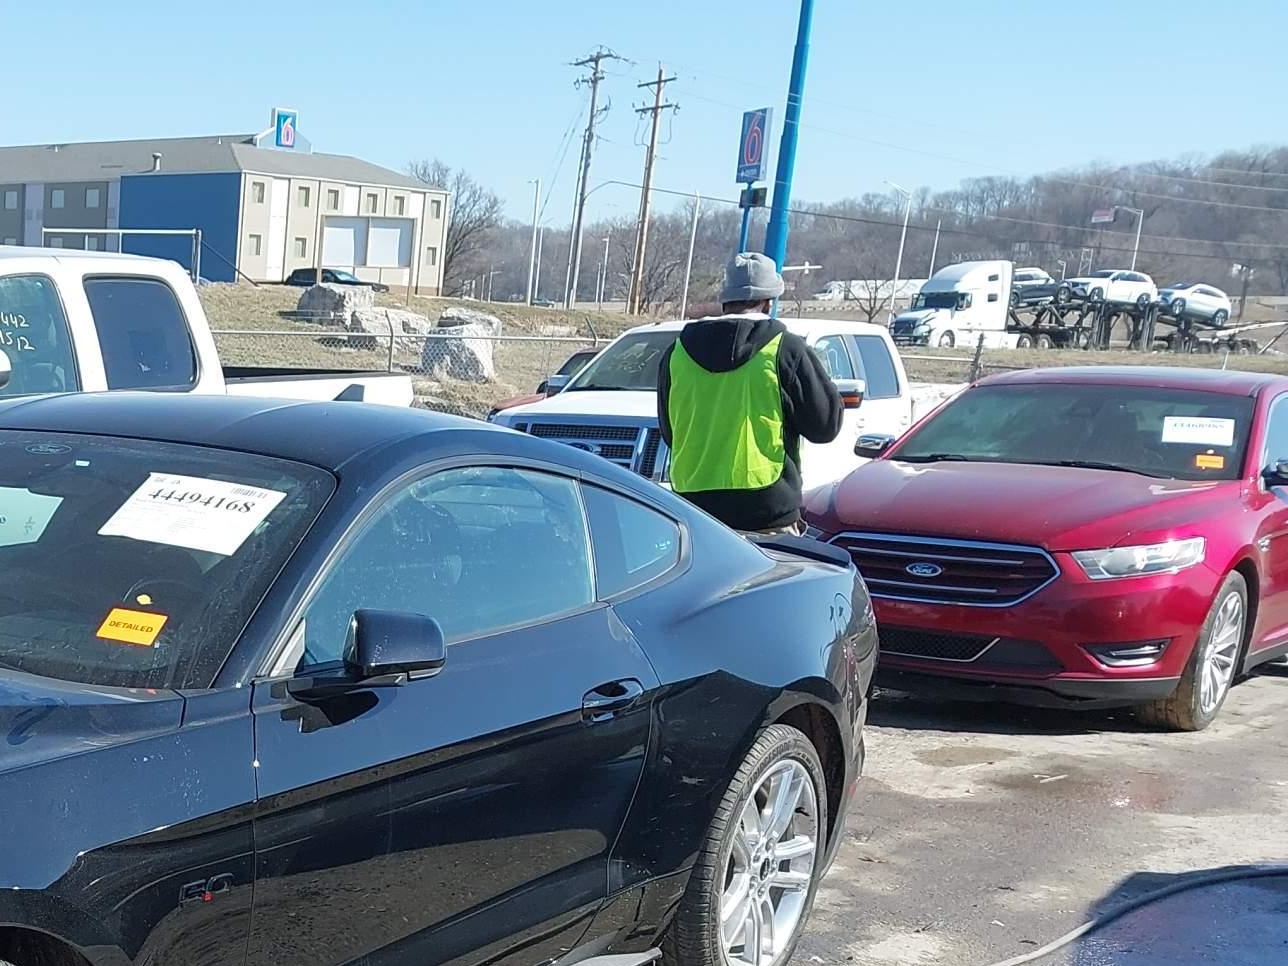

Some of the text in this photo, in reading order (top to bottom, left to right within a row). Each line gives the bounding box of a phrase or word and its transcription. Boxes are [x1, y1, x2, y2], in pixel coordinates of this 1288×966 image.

[281, 116, 294, 146] 6
[744, 112, 762, 165] 6
[148, 488, 256, 513] 44494168
[108, 620, 154, 633] DETAILED
